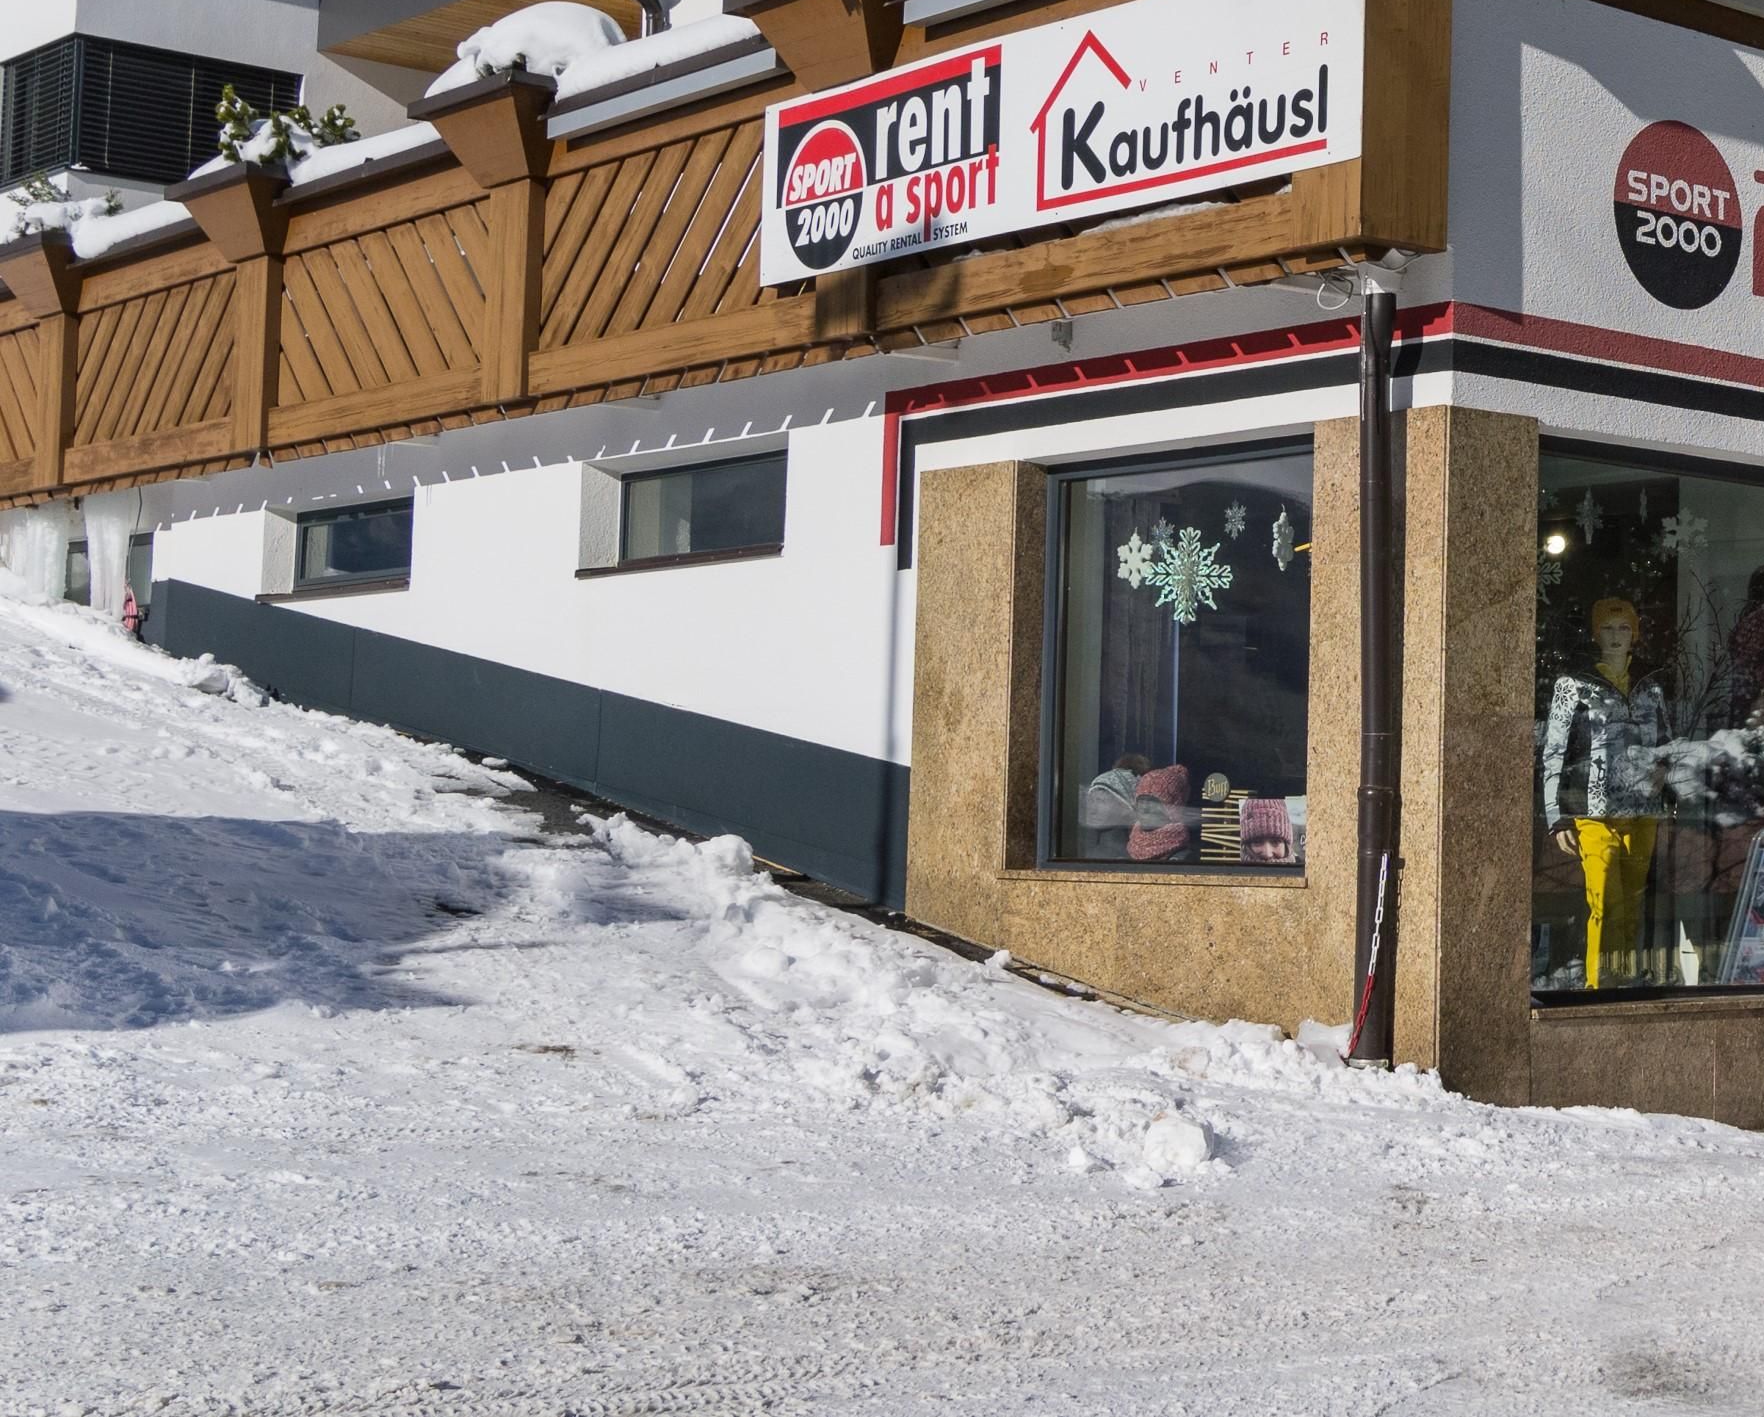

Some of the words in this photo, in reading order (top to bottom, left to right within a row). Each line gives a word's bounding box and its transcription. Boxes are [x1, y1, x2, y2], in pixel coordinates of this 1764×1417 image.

[1139, 31, 1330, 93] VENTER
[875, 57, 990, 180] rent
[1061, 64, 1329, 191] Kaufhäusl
[789, 152, 857, 202] SPORT
[875, 182, 894, 232] a
[905, 144, 1000, 242] sport
[1627, 170, 1731, 221] SPORT
[795, 198, 855, 247] 2000
[852, 240, 888, 260] QUALITY
[890, 232, 923, 251] RENTAL
[933, 222, 968, 241] SYSTEM
[1636, 210, 1722, 257] 2000
